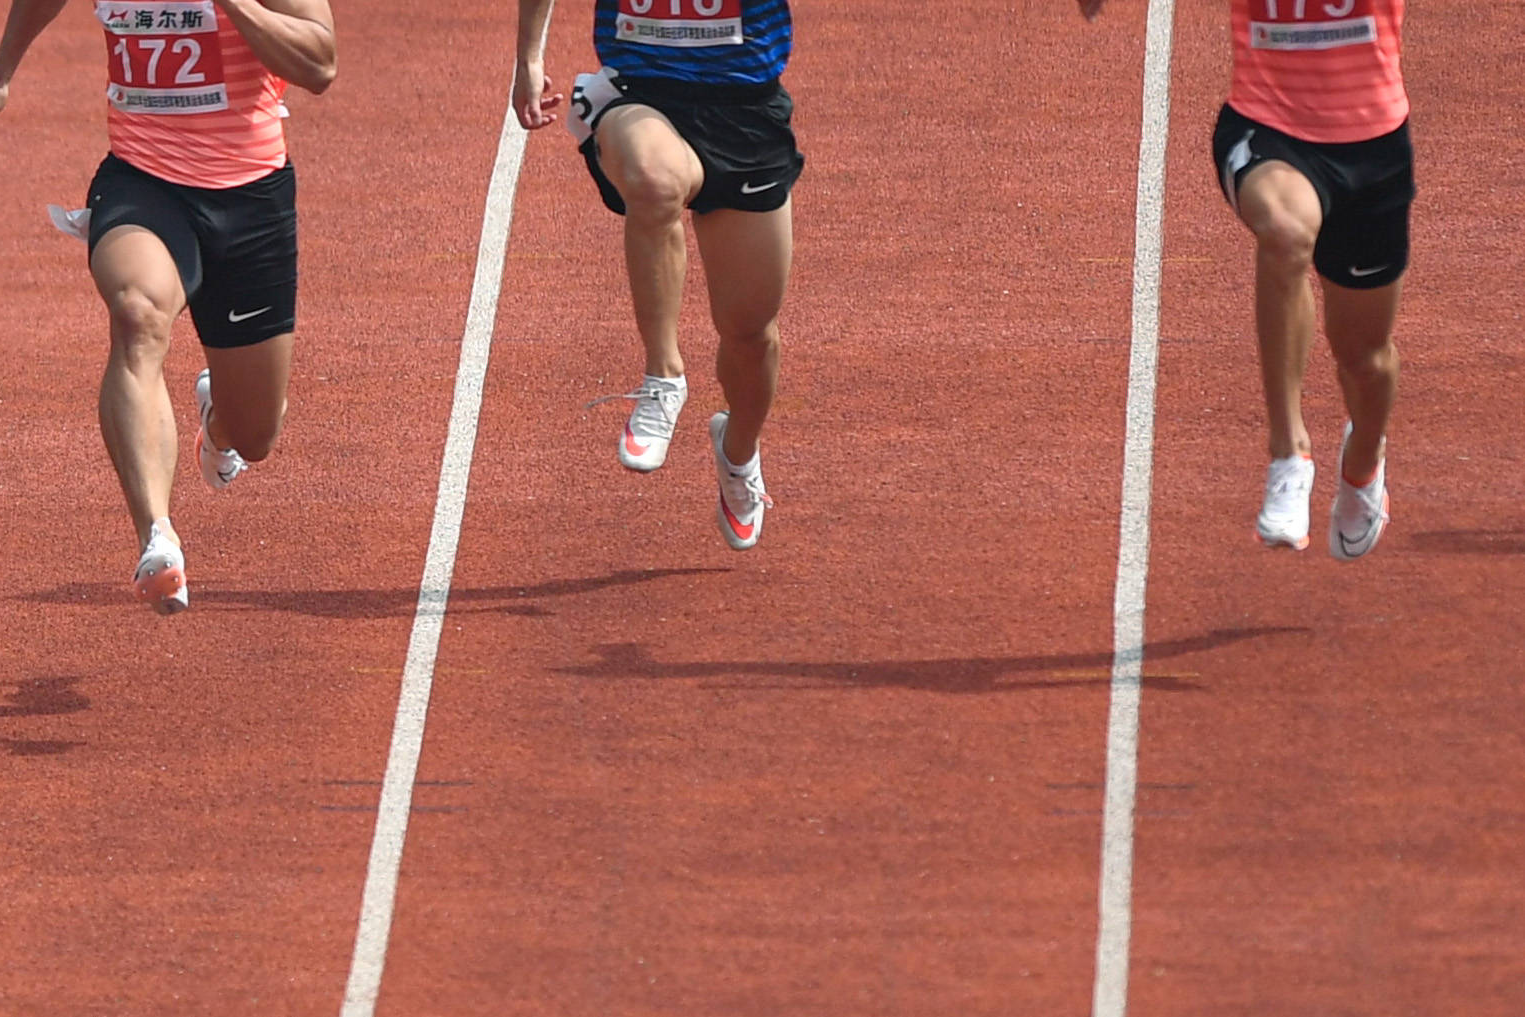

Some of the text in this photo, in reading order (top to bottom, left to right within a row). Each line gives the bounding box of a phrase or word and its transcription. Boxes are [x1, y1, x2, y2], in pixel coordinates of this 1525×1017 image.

[135, 9, 204, 30] 海尔斯
[114, 37, 206, 85] 172
